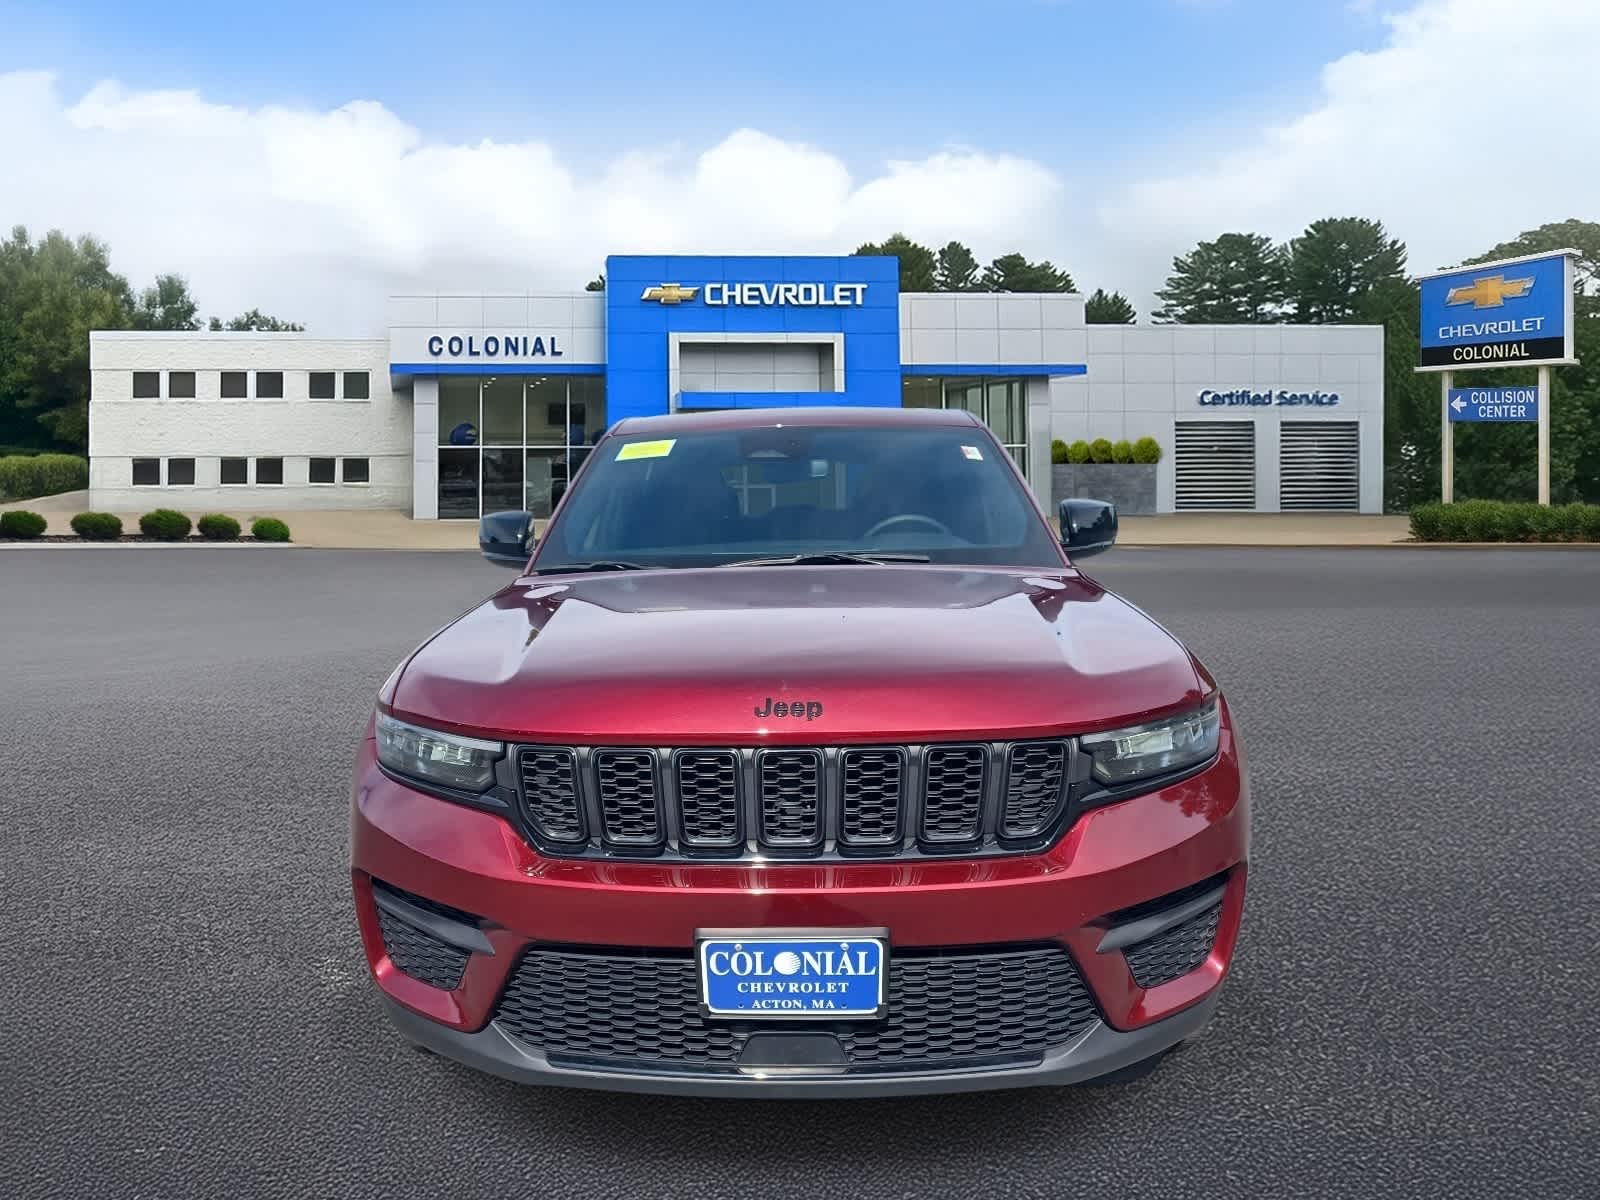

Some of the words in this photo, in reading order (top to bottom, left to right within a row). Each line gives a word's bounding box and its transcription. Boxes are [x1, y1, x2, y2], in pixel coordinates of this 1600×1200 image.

[704, 283, 868, 305] CHEVROLET
[1438, 317, 1545, 339] CHEVROLET
[428, 336, 563, 357] COLONIAL
[1453, 343, 1530, 361] COLONIAL
[1199, 390, 1272, 406] Certified
[1277, 390, 1339, 406] Service
[1471, 390, 1535, 404] COLLISION
[1478, 405, 1526, 418] CENTER
[754, 697, 823, 721] Jeep
[709, 951, 876, 976] COLONIAL
[737, 982, 849, 993] CHEVROLET
[752, 999, 807, 1010] ACTON,
[812, 999, 835, 1009] MA
